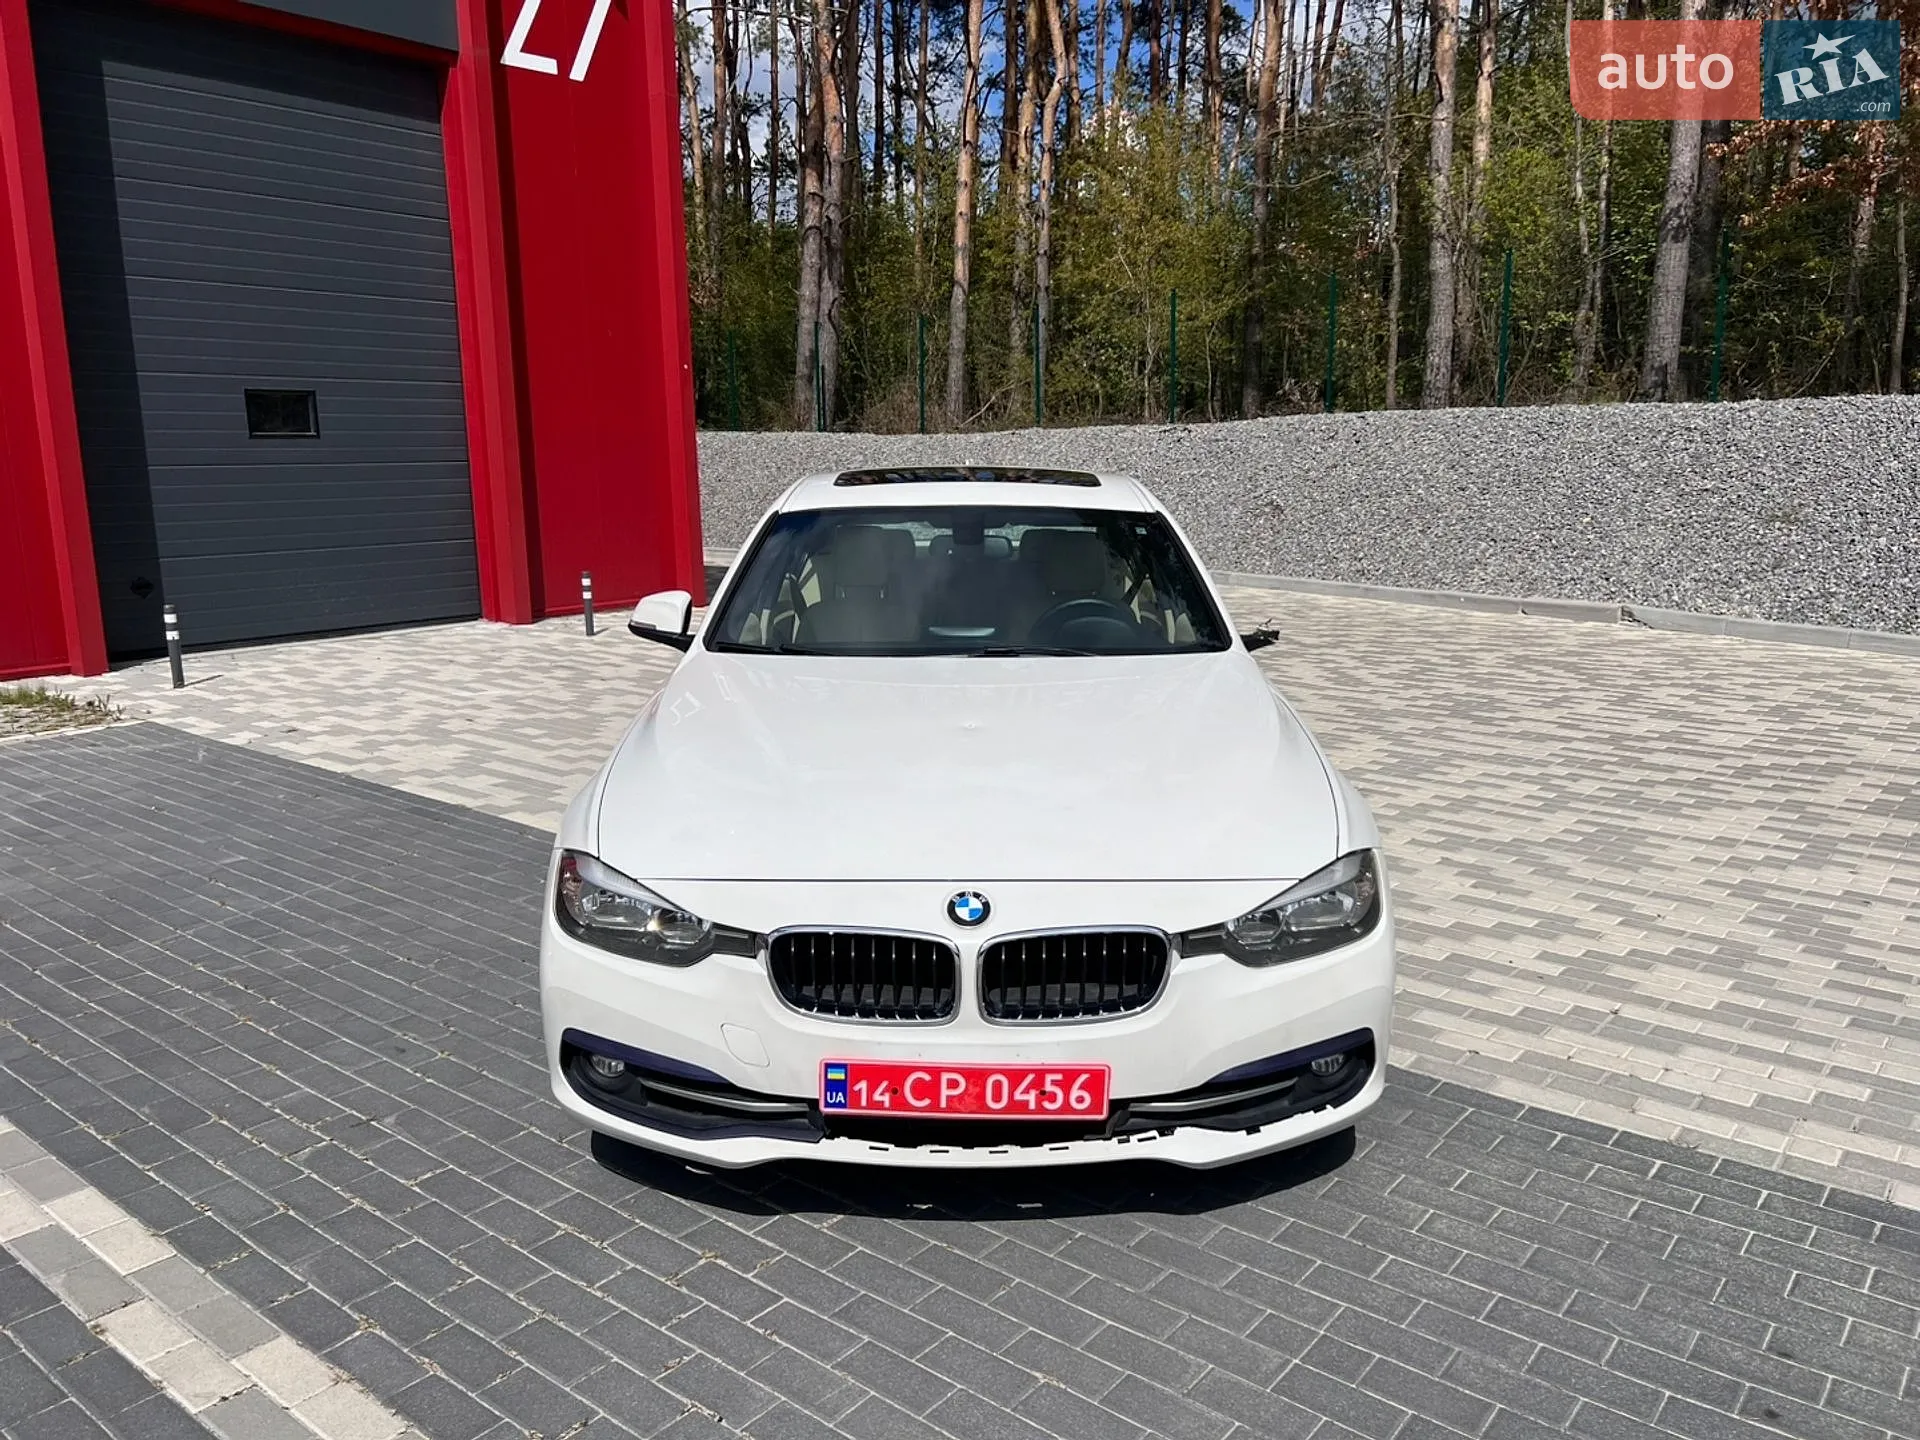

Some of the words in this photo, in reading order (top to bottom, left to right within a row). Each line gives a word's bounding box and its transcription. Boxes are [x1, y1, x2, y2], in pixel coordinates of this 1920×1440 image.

[826, 1091, 846, 1104] UA
[852, 1079, 890, 1108] 14
[903, 1071, 967, 1109] CP
[985, 1073, 1092, 1110] 0456
